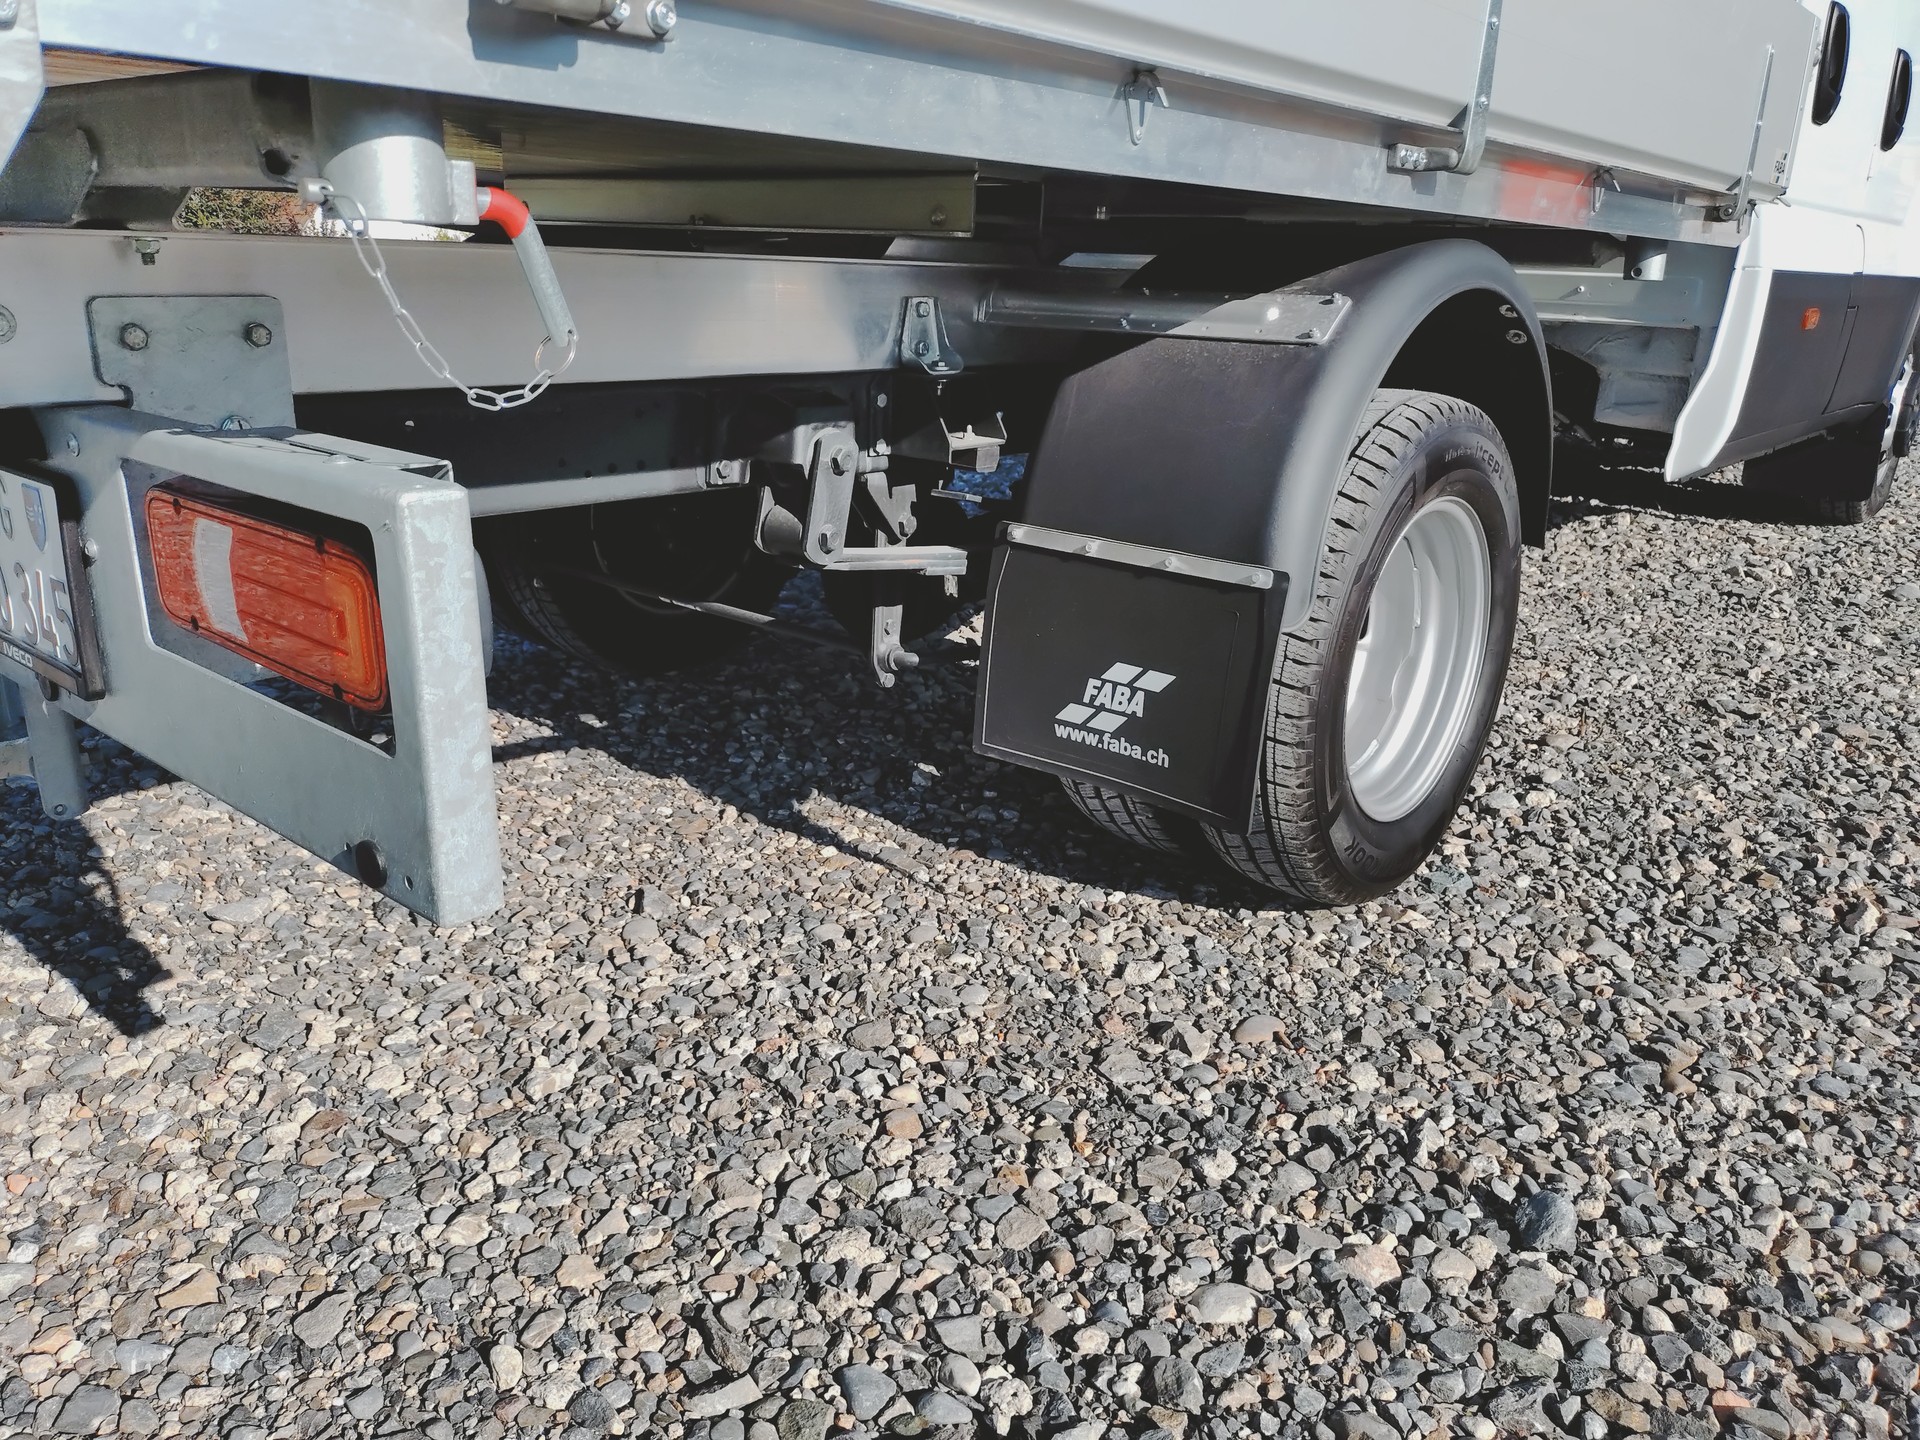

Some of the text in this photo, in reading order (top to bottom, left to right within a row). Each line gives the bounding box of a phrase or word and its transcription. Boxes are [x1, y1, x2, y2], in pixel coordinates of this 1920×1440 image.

[3, 641, 33, 668] IVECO
[1082, 677, 1145, 718] FABA
[1054, 723, 1169, 768] www.faba.ch
